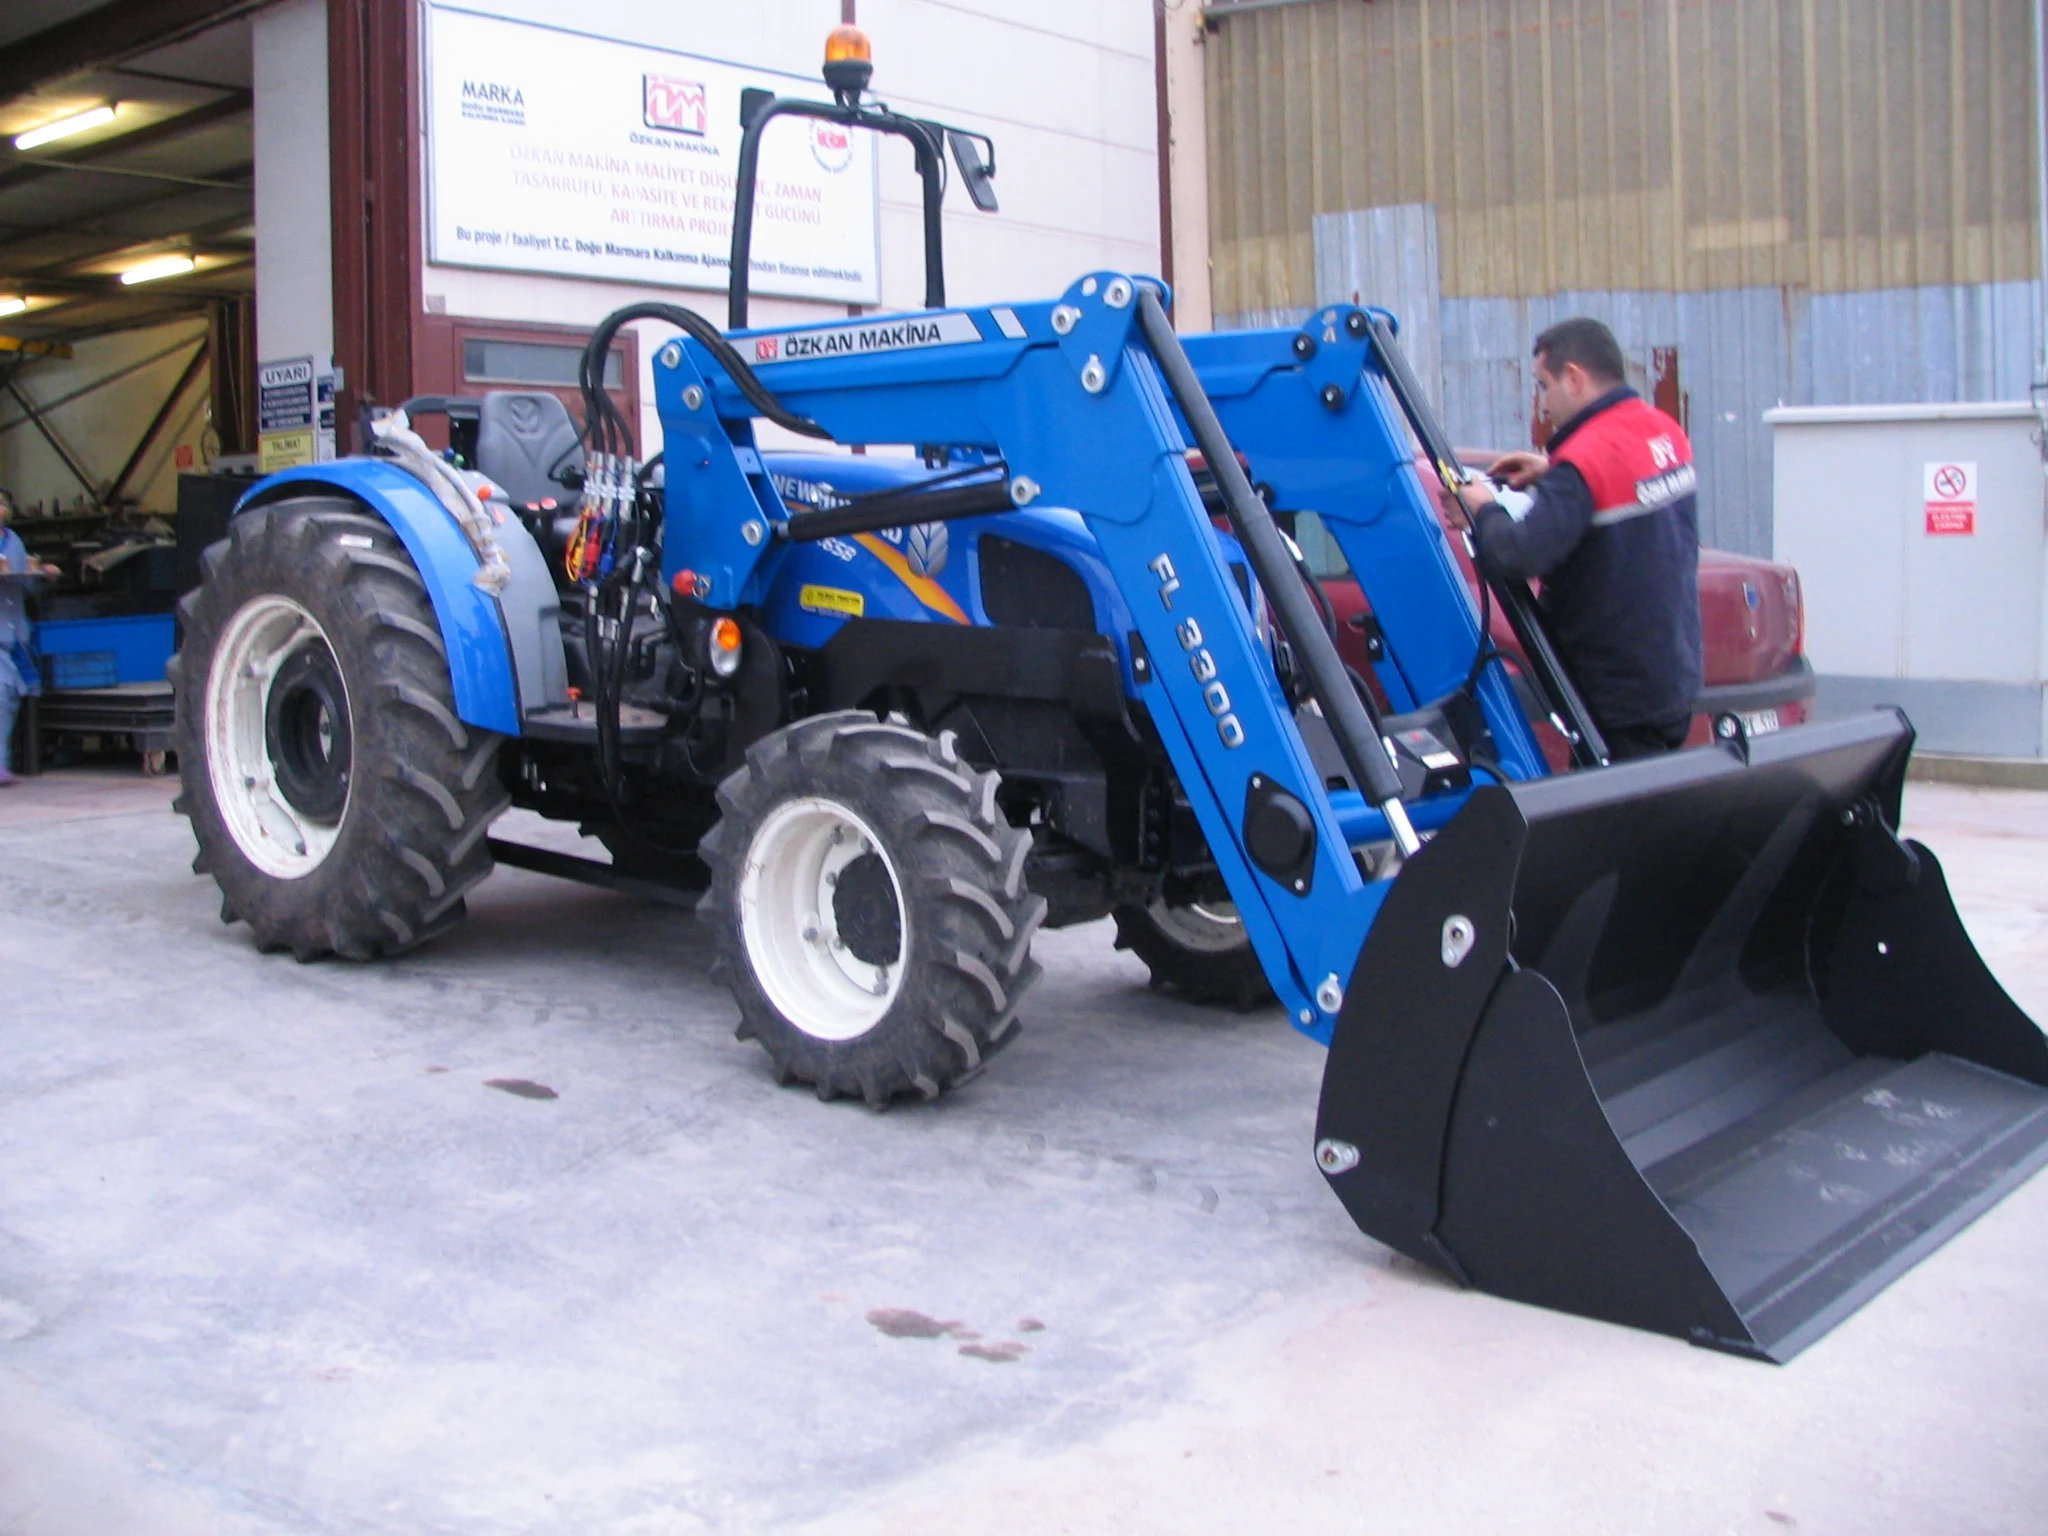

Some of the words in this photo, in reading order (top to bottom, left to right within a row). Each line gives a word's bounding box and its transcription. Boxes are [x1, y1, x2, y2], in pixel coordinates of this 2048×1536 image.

[462, 79, 525, 106] MARKA
[510, 141, 565, 165] ÖZKAN
[568, 151, 631, 176] MAKİNA
[635, 160, 695, 184] MALİYET
[774, 181, 822, 202] ZAMAN
[681, 193, 700, 209] VE
[456, 225, 472, 242] Bu
[475, 229, 502, 247] proje
[512, 231, 551, 251] faaliyet
[554, 236, 572, 252] T.C.
[605, 242, 650, 260] Marmara
[785, 333, 853, 357] ÖZKAN
[859, 321, 942, 350] MAKİNA
[265, 366, 307, 384] UYARI
[1148, 552, 1181, 612] FL
[1175, 616, 1246, 750] 3300
